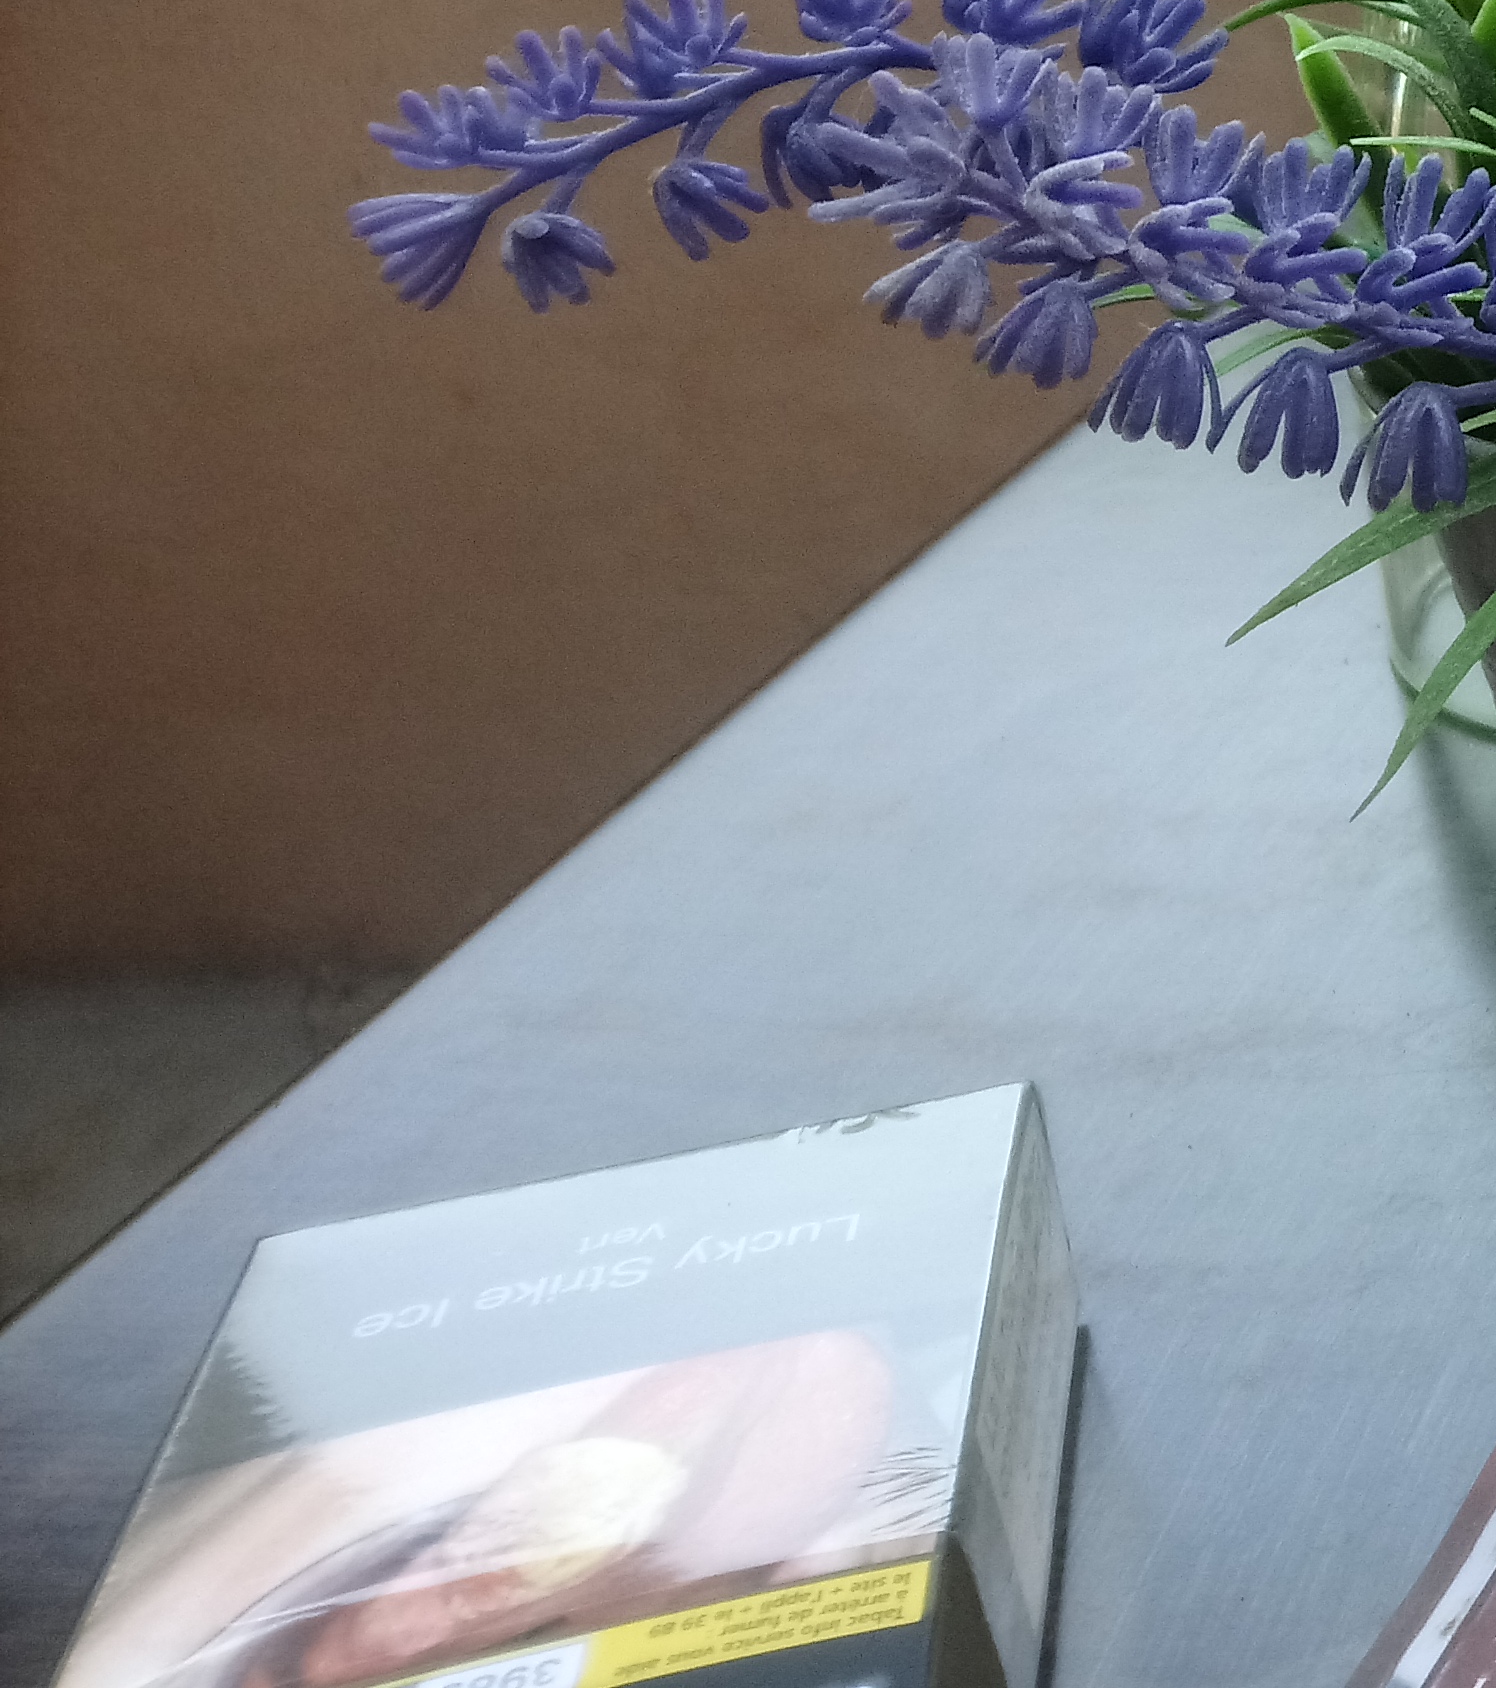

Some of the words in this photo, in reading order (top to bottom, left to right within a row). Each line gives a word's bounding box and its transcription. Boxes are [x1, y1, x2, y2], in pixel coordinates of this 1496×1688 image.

[674, 1212, 862, 1271] Lucky
[474, 1255, 654, 1312] Strike
[352, 1297, 450, 1339] Ice
[845, 1605, 905, 1627] Tabac
